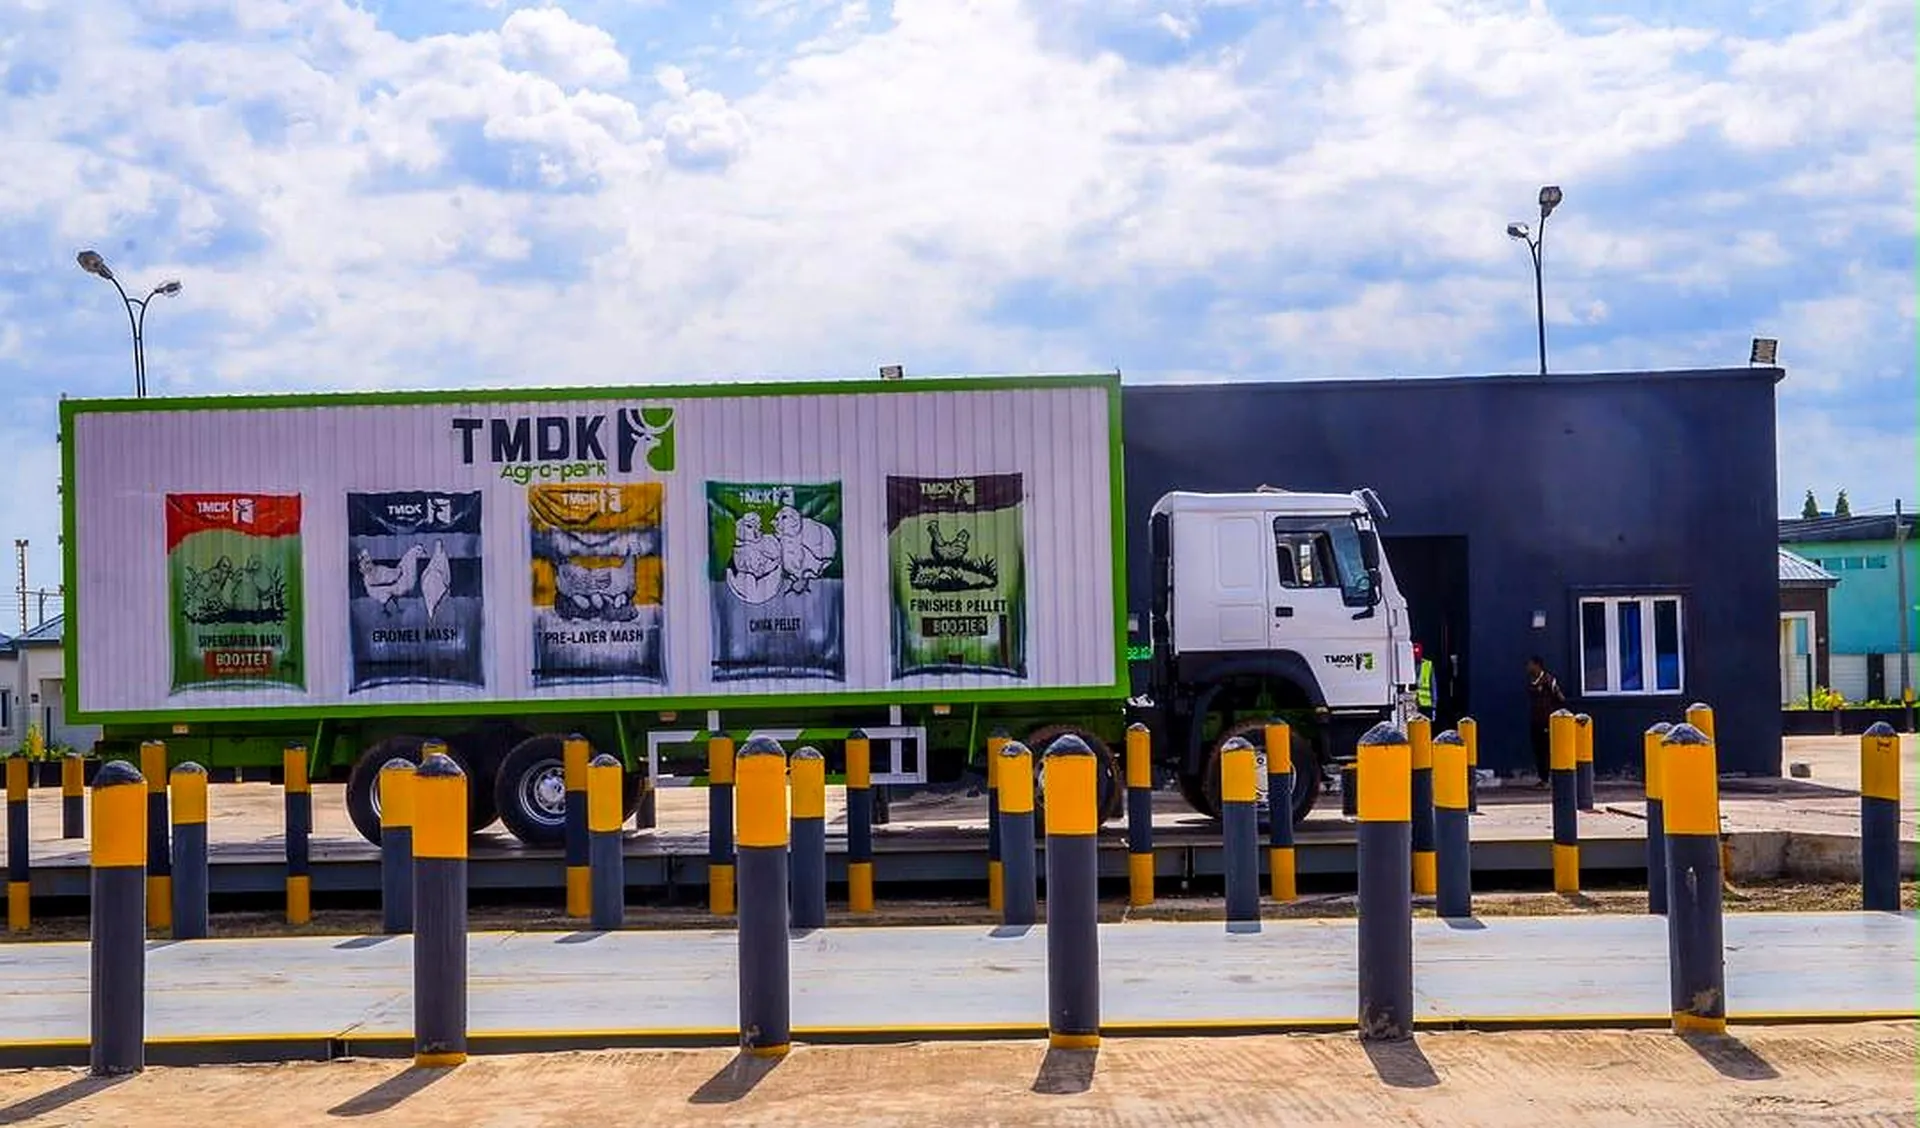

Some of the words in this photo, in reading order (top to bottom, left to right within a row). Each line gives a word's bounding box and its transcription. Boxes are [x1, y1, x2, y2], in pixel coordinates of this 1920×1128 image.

[452, 415, 607, 464] TMDK
[501, 462, 607, 485] Agro-park
[920, 482, 953, 495] TMDK
[561, 492, 598, 505] TMDK
[197, 501, 230, 513] TMDK
[910, 600, 962, 613] FINISHER
[966, 600, 1007, 612] PELLET
[933, 619, 986, 634] BOOSTER
[545, 631, 607, 644] PRE-LAYER
[611, 629, 644, 642] MASH
[1324, 654, 1354, 663] TMDK
